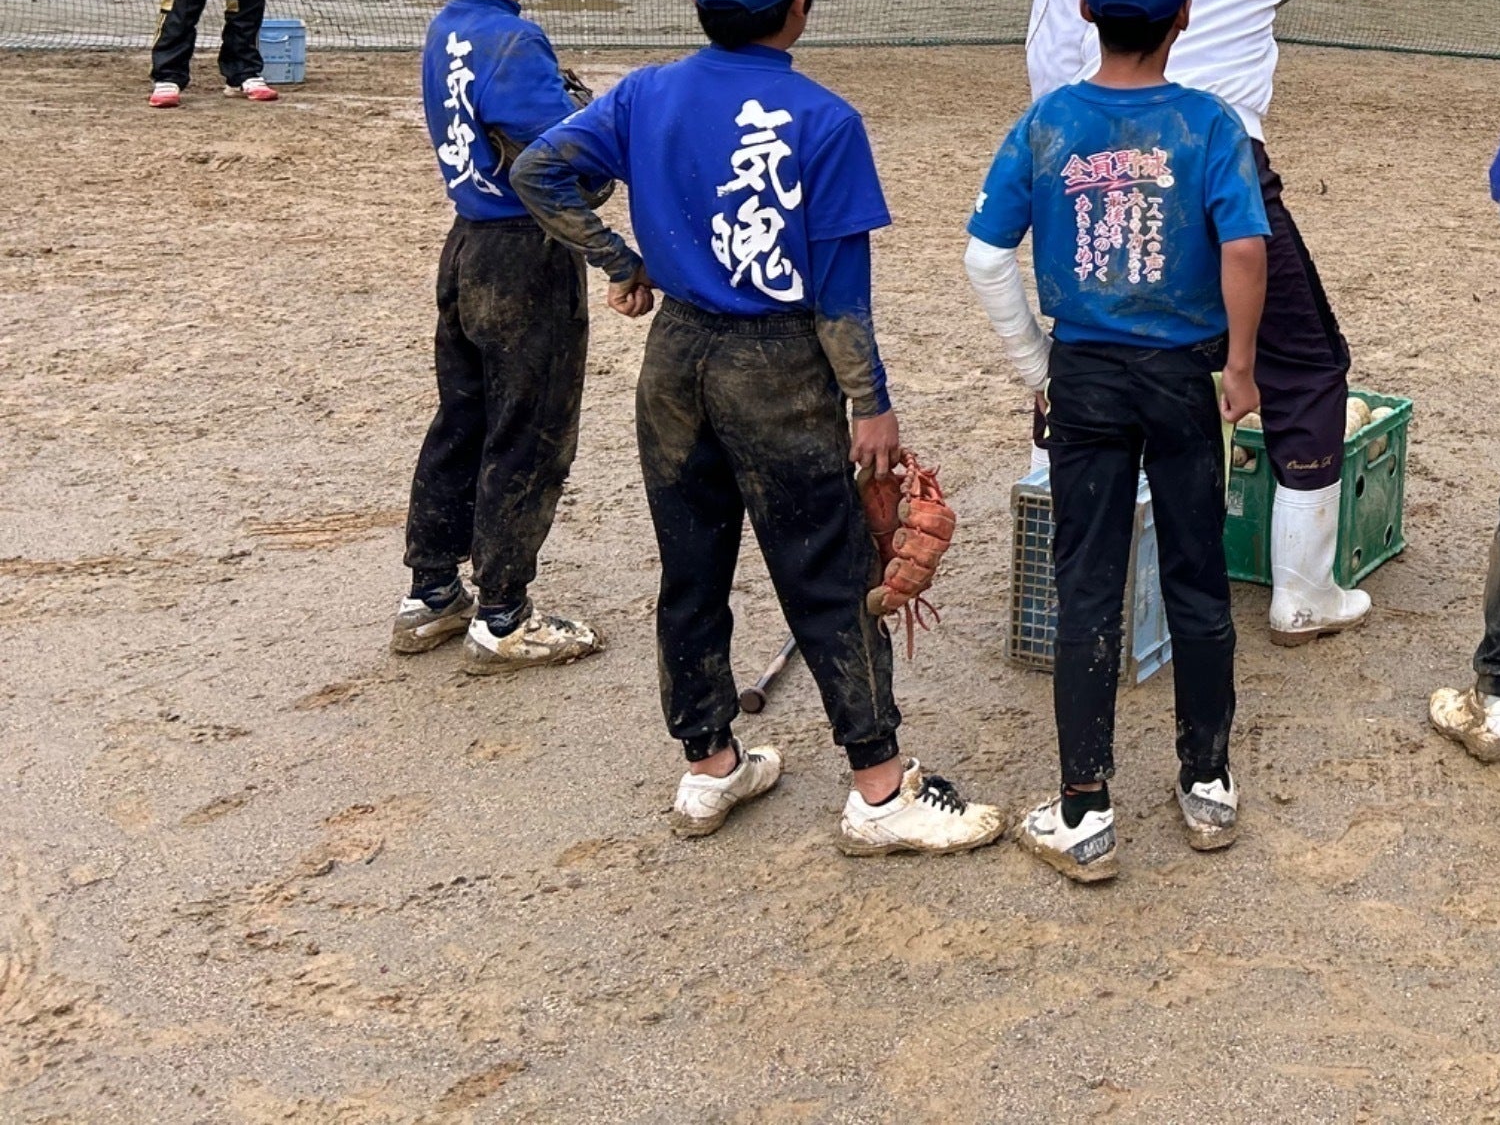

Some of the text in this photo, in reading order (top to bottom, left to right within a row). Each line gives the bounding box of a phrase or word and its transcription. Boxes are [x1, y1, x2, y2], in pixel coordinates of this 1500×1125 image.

[1060, 147, 1172, 186] 全員野球
[1074, 193, 1093, 282] あきらめず
[1093, 220, 1111, 282] たのしく
[1142, 196, 1165, 283] 一人一人の声が
